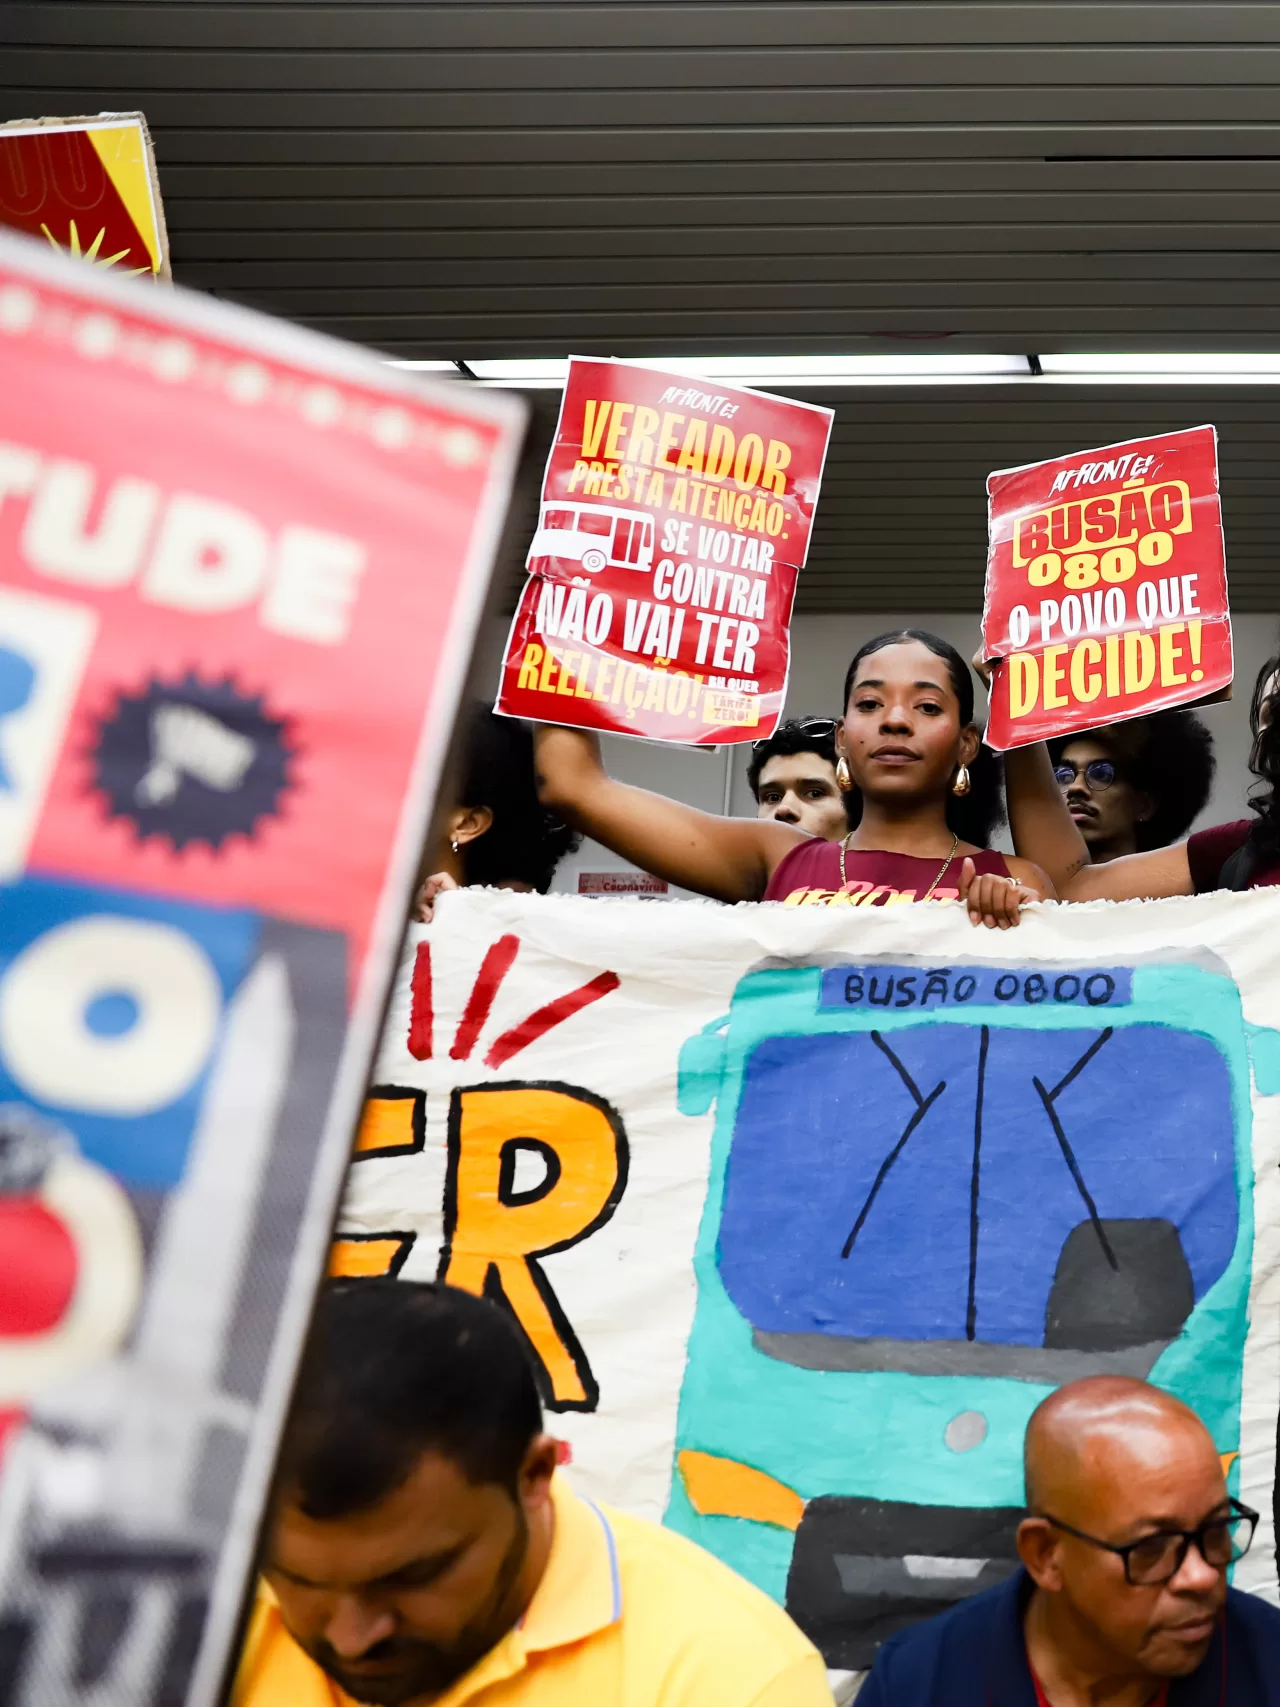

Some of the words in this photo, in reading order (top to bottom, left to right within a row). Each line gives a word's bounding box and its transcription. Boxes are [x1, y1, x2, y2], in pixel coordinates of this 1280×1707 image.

[658, 386, 739, 419] AFRONTE!
[580, 399, 792, 499] VEREADOR
[1049, 452, 1155, 497] AFRONTE!
[567, 459, 662, 510] PRESTA
[673, 477, 791, 539] ATENÇÃO:
[1019, 478, 1184, 559] BUSÃO
[661, 518, 689, 557] SE
[698, 526, 775, 575] VOTAR
[1027, 531, 1174, 589] 0800
[653, 559, 767, 620] CONTRA
[1008, 605, 1030, 647] O
[1039, 587, 1127, 641] POVO
[1136, 574, 1201, 629] QUE
[535, 576, 613, 646] NÃO
[622, 599, 685, 660] VAI
[695, 612, 761, 674] TER
[517, 642, 707, 720] REELEIÇÃO!
[727, 677, 759, 693] QUER
[1008, 619, 1204, 719] DECIDE!
[844, 968, 975, 1007] BUSÃO
[994, 973, 1116, 1006] 0800
